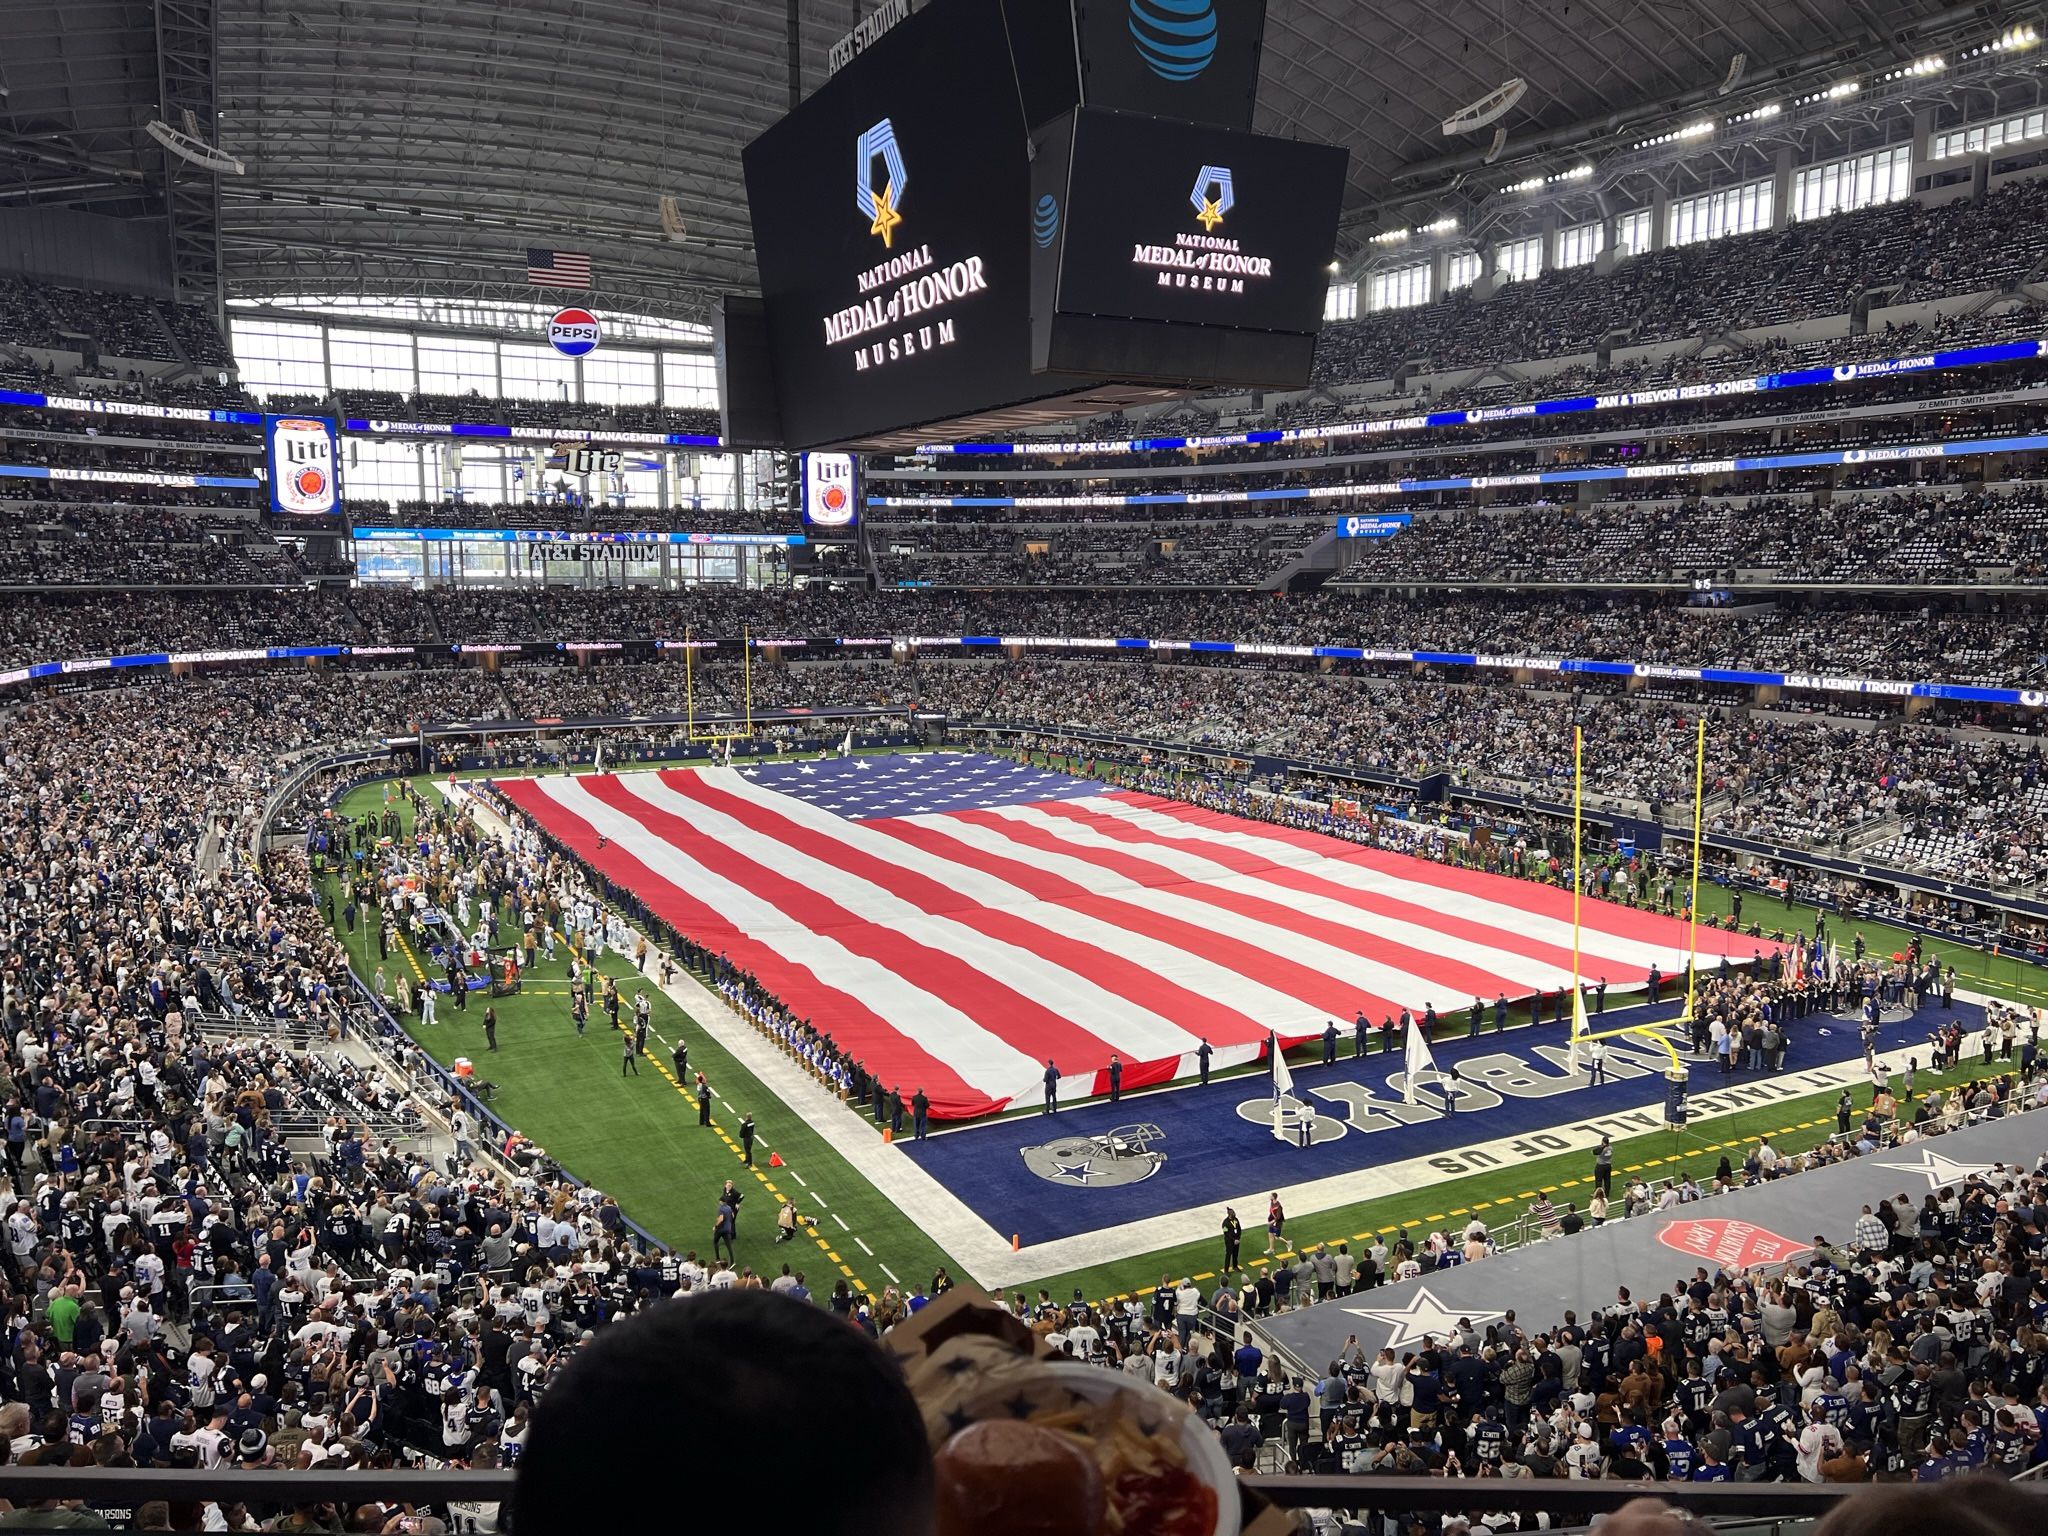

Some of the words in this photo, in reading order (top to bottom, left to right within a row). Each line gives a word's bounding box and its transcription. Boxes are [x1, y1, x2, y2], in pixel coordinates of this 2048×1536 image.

[828, 31, 855, 76] AT&T
[854, 0, 908, 55] STADIUM
[1175, 233, 1239, 252] NATIONAL
[1132, 244, 1196, 268] MEDAL
[1196, 252, 1209, 270] of
[1208, 252, 1272, 276] HONOR
[857, 244, 933, 293] NATIONAL
[1158, 272, 1244, 293] MUSEUM
[823, 296, 889, 345] MEDAL
[887, 291, 901, 322] of
[900, 255, 988, 316] HONOR
[551, 325, 598, 340] PEPSI
[854, 318, 955, 371] MUSEUM
[1857, 363, 1890, 375] MEDAL
[1899, 356, 1934, 369] HONOR
[1596, 395, 1619, 408] JAN
[1620, 395, 1630, 405] &
[1631, 388, 1678, 404] TREVOR
[1680, 379, 1756, 399] REES-JONES
[47, 396, 90, 411] KAREN
[93, 401, 104, 413] &
[105, 402, 164, 417] STEPHEN
[166, 407, 210, 421] JONES
[1928, 399, 1958, 408] EMMITT
[1961, 396, 1985, 405] SMITH
[1484, 409, 1506, 417] MEDAL
[1511, 406, 1536, 415] HONOR
[1781, 415, 1798, 423] TROY
[1800, 413, 1825, 421] AIKMAN
[390, 422, 418, 430] MEDAL
[423, 424, 452, 432] HONOR
[1282, 430, 1298, 440] J.B.
[1299, 428, 1319, 439] AND
[1319, 423, 1364, 438] JOHNELLE
[1365, 420, 1392, 432] HUNT
[1393, 416, 1427, 430] FAMILY
[16, 430, 36, 438] DREW
[37, 432, 68, 440] PEARSON
[511, 428, 551, 438] KARLIN
[554, 430, 590, 440] ASSET
[591, 431, 666, 443] MANAGEMENT
[285, 438, 328, 465] Lite
[1013, 444, 1023, 452] IN
[1026, 443, 1061, 453] HONOR
[1063, 443, 1077, 452] OF
[1077, 442, 1097, 452] JOE
[1098, 440, 1130, 451] CLARK
[1868, 450, 1901, 461] MEDAL
[1908, 446, 1944, 457] HONOR
[564, 448, 621, 477] Lite
[1627, 464, 1675, 478] KENNETH
[1677, 463, 1689, 474] C.
[1690, 460, 1735, 473] GRIFFIN
[49, 468, 78, 480] KYLE
[80, 469, 90, 480] &
[91, 470, 162, 485] ALEXANDRA
[163, 475, 196, 485] BASS
[816, 461, 850, 483] Lite
[1488, 478, 1512, 486] MEDAL
[1516, 475, 1541, 484] HONOR
[1309, 486, 1346, 497] KATHRYN
[1353, 485, 1379, 495] CRAIG
[1380, 482, 1402, 492] HALL
[1015, 497, 1062, 506] KATHERINE
[1063, 497, 1092, 505] PEROT
[1093, 496, 1125, 505] REEVES
[570, 532, 588, 541] 6:15
[530, 545, 575, 561] AT&T
[580, 545, 658, 561] STADIUM
[351, 646, 414, 654] Blockchain.com
[461, 643, 521, 652] Blockchain.com
[565, 642, 622, 650] Blockchain.com
[664, 640, 718, 648] Blockchain.com
[756, 639, 807, 647] Blockchain.com
[1070, 639, 1117, 648] STEPHENSON
[1276, 646, 1312, 655] STALLINGS
[168, 653, 201, 663] LOEWS
[203, 649, 267, 662] CORPORATION
[1476, 656, 1495, 666] LISA
[1502, 657, 1525, 668] CLAY
[1526, 659, 1561, 670] COOLEY
[1651, 667, 1672, 676] MEDAL
[1678, 669, 1701, 678] HONOR
[1784, 675, 1810, 688] LISA
[1811, 676, 1820, 688] &
[1822, 677, 1864, 691] KENNY
[1865, 680, 1914, 695] TROUTT
[1237, 1024, 1722, 1148] OWBOYS
[1797, 1072, 1847, 1089] IT
[1573, 1112, 1662, 1143] ALL
[1508, 1133, 1572, 1158] OF
[1428, 1150, 1503, 1174] US
[159, 1224, 171, 1237] 11
[333, 1225, 348, 1236] 40
[384, 1220, 399, 1233] 32
[529, 1221, 537, 1235] 8
[1684, 1223, 1717, 1253] ARMY
[1714, 1221, 1753, 1265] SALVATION
[1751, 1238, 1781, 1259] THE
[662, 1268, 678, 1281] 55
[1404, 1269, 1417, 1279] 56
[281, 1302, 291, 1317] 11
[1165, 1361, 1174, 1375] 4
[424, 1379, 440, 1395] 68
[1694, 1393, 1705, 1410] 11
[102, 1408, 120, 1423] 82
[448, 1419, 457, 1431] 4
[1754, 1432, 1763, 1449] 4
